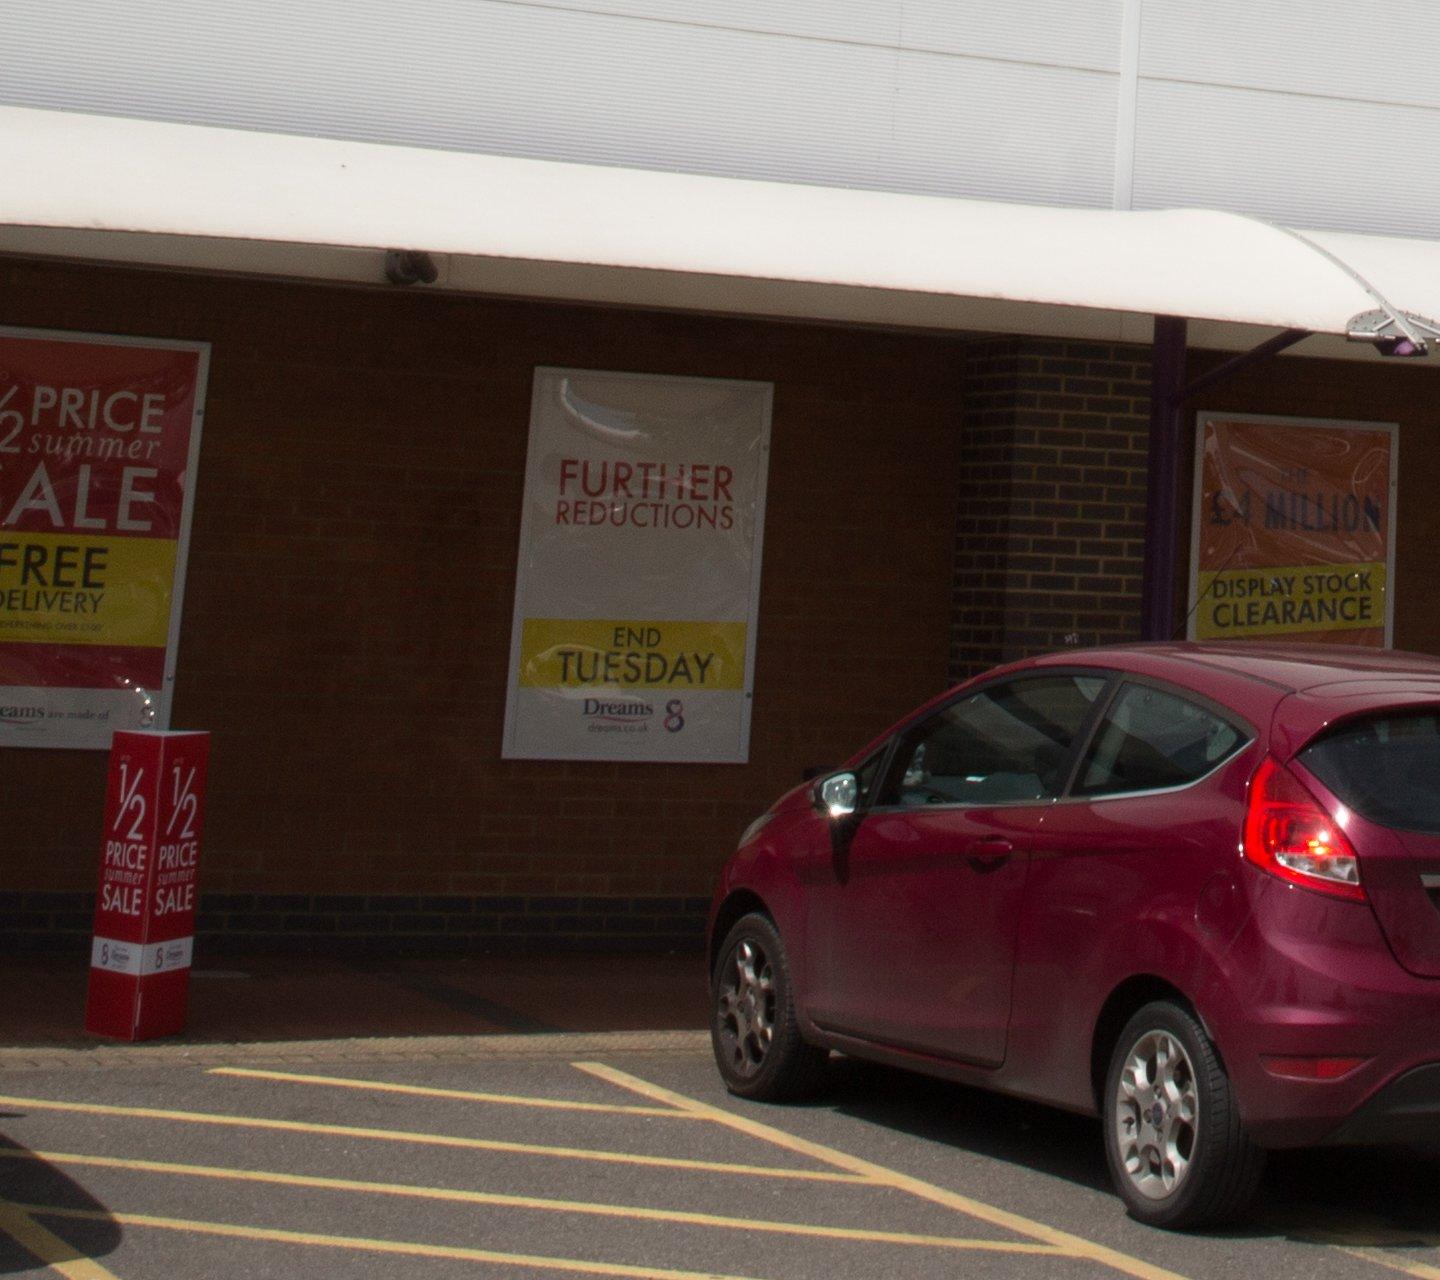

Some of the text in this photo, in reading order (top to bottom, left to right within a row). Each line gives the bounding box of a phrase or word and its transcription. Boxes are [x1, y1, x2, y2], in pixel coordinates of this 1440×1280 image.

[31, 385, 166, 434] PRICE
[27, 431, 161, 462] summer
[558, 459, 734, 501] FURTHER
[556, 500, 734, 530] REDUCTIONS
[1263, 490, 1381, 535] MILLION
[1213, 571, 1372, 599] DISPLAY STOCK
[1212, 596, 1372, 628] CLEARANCE
[612, 626, 661, 648] END
[557, 651, 714, 683] TUESDAY
[47, 710, 66, 719] are
[582, 699, 653, 716] Dreams
[587, 722, 649, 734] dreams.co.uk
[105, 840, 148, 870] PRICE
[158, 841, 197, 871] PRICE
[104, 868, 144, 885] summer
[157, 868, 195, 885] summer
[102, 883, 141, 916] SALE
[154, 884, 194, 916] SALE
